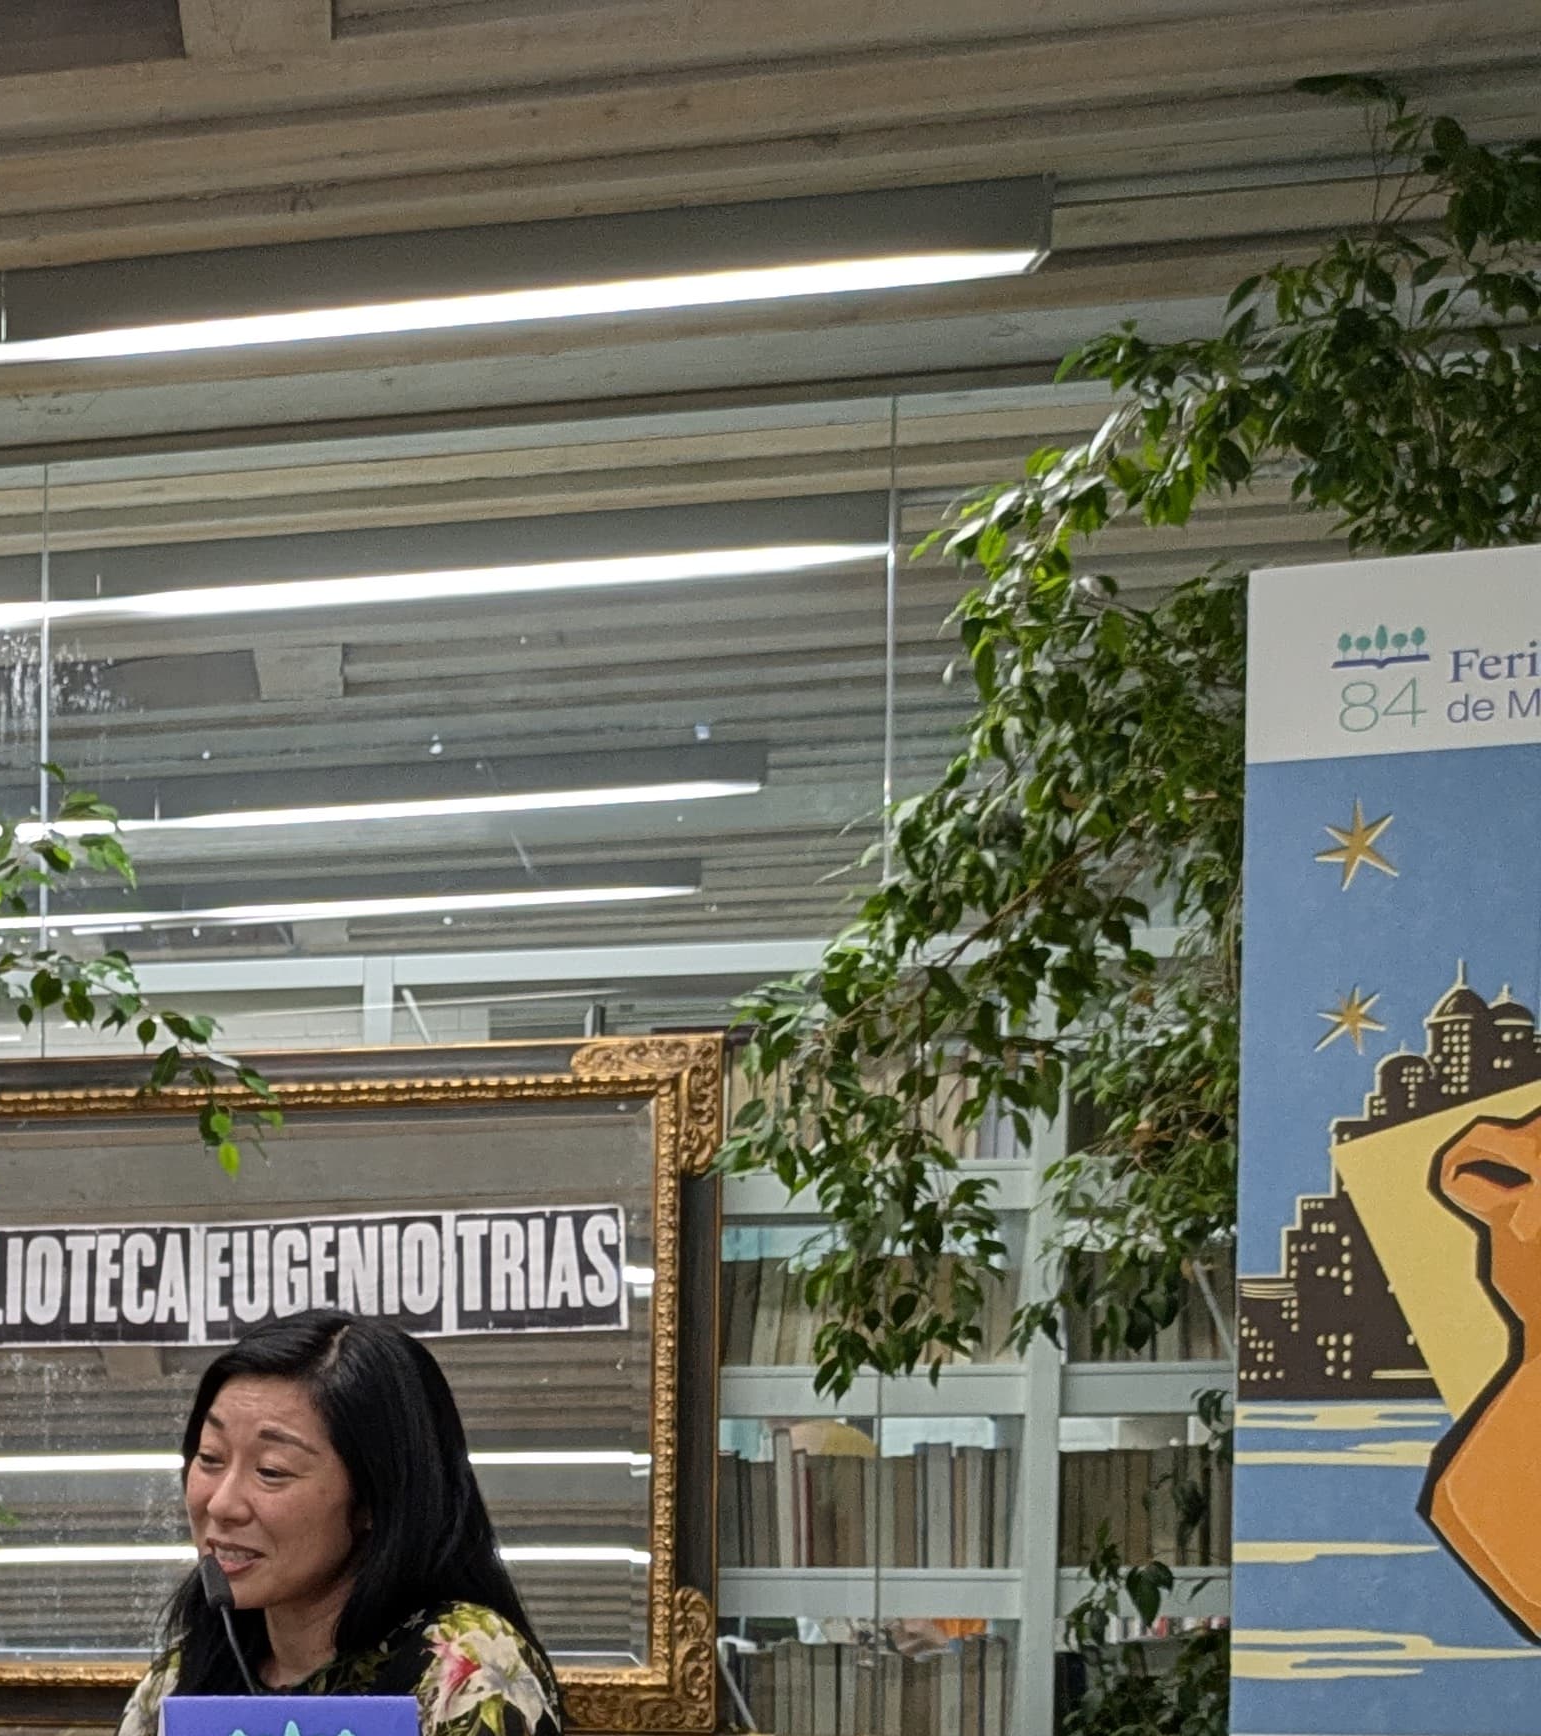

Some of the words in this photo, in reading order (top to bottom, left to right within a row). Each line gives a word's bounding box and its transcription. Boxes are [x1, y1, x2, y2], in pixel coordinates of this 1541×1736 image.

[1339, 678, 1427, 732] 84
[1449, 641, 1541, 682] Feri
[1447, 694, 1494, 723] de
[206, 1222, 441, 1322] EUGENIO
[457, 1213, 619, 1312] TRIAS
